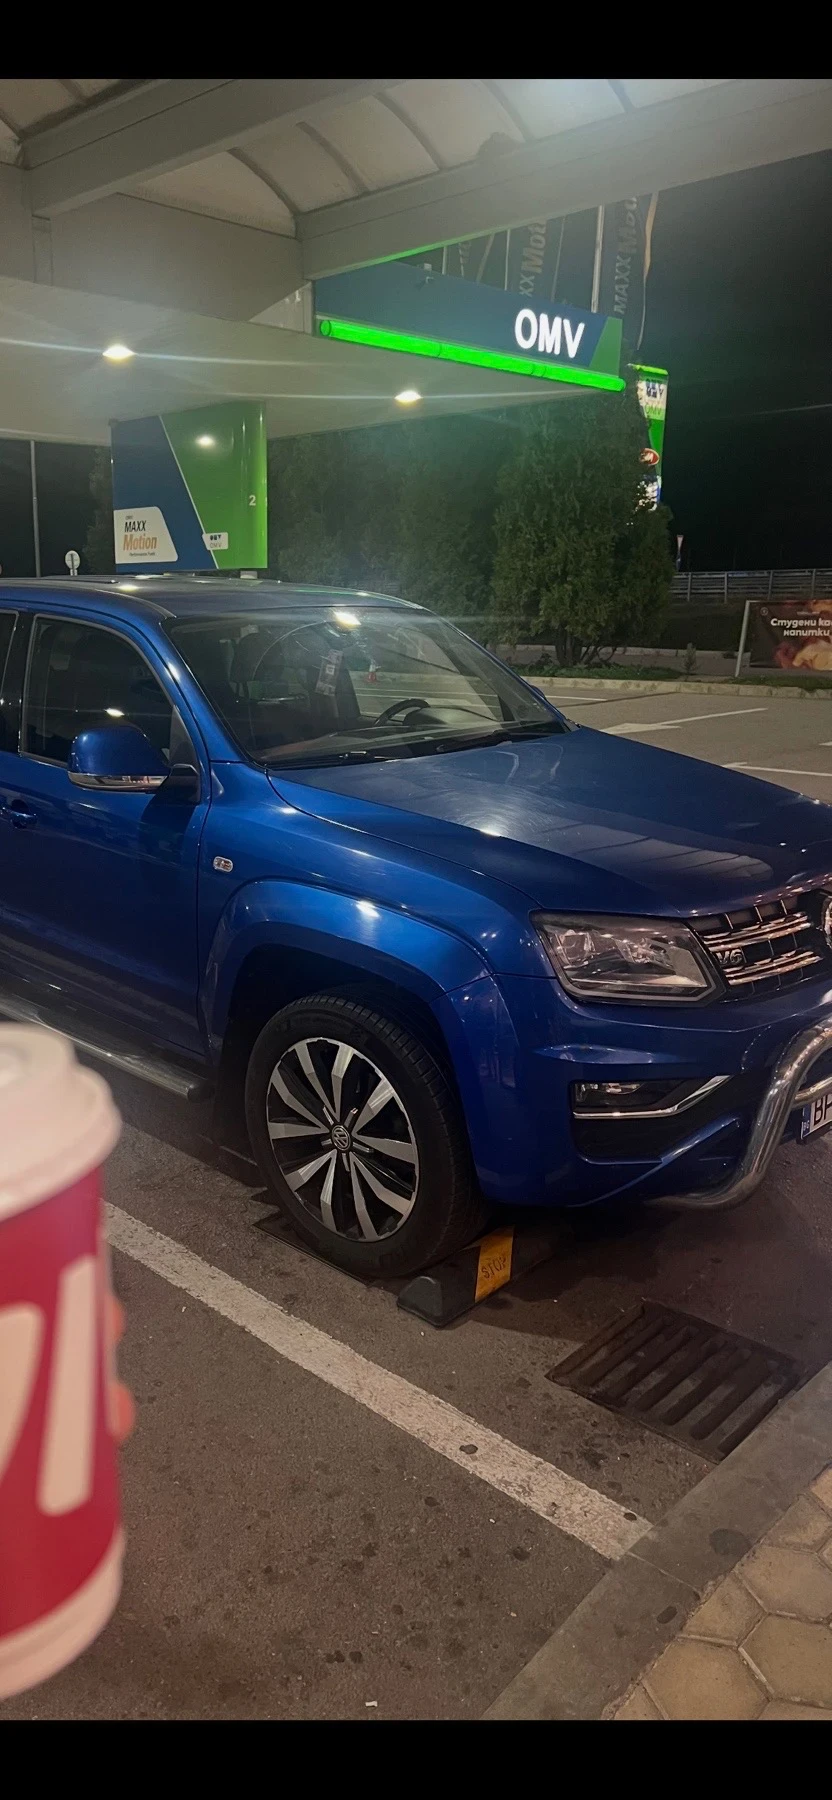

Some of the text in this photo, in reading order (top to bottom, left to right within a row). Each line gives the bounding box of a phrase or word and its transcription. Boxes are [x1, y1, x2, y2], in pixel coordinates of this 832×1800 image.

[613, 255, 632, 315] MAXX
[514, 308, 585, 358] OMV
[248, 494, 256, 506] 2
[124, 520, 147, 533] MAXX
[123, 533, 158, 551] Motion
[770, 617, 832, 628] Студени ка
[783, 628, 830, 637] напитки
[715, 946, 743, 965] V6
[481, 1255, 507, 1279] STOP
